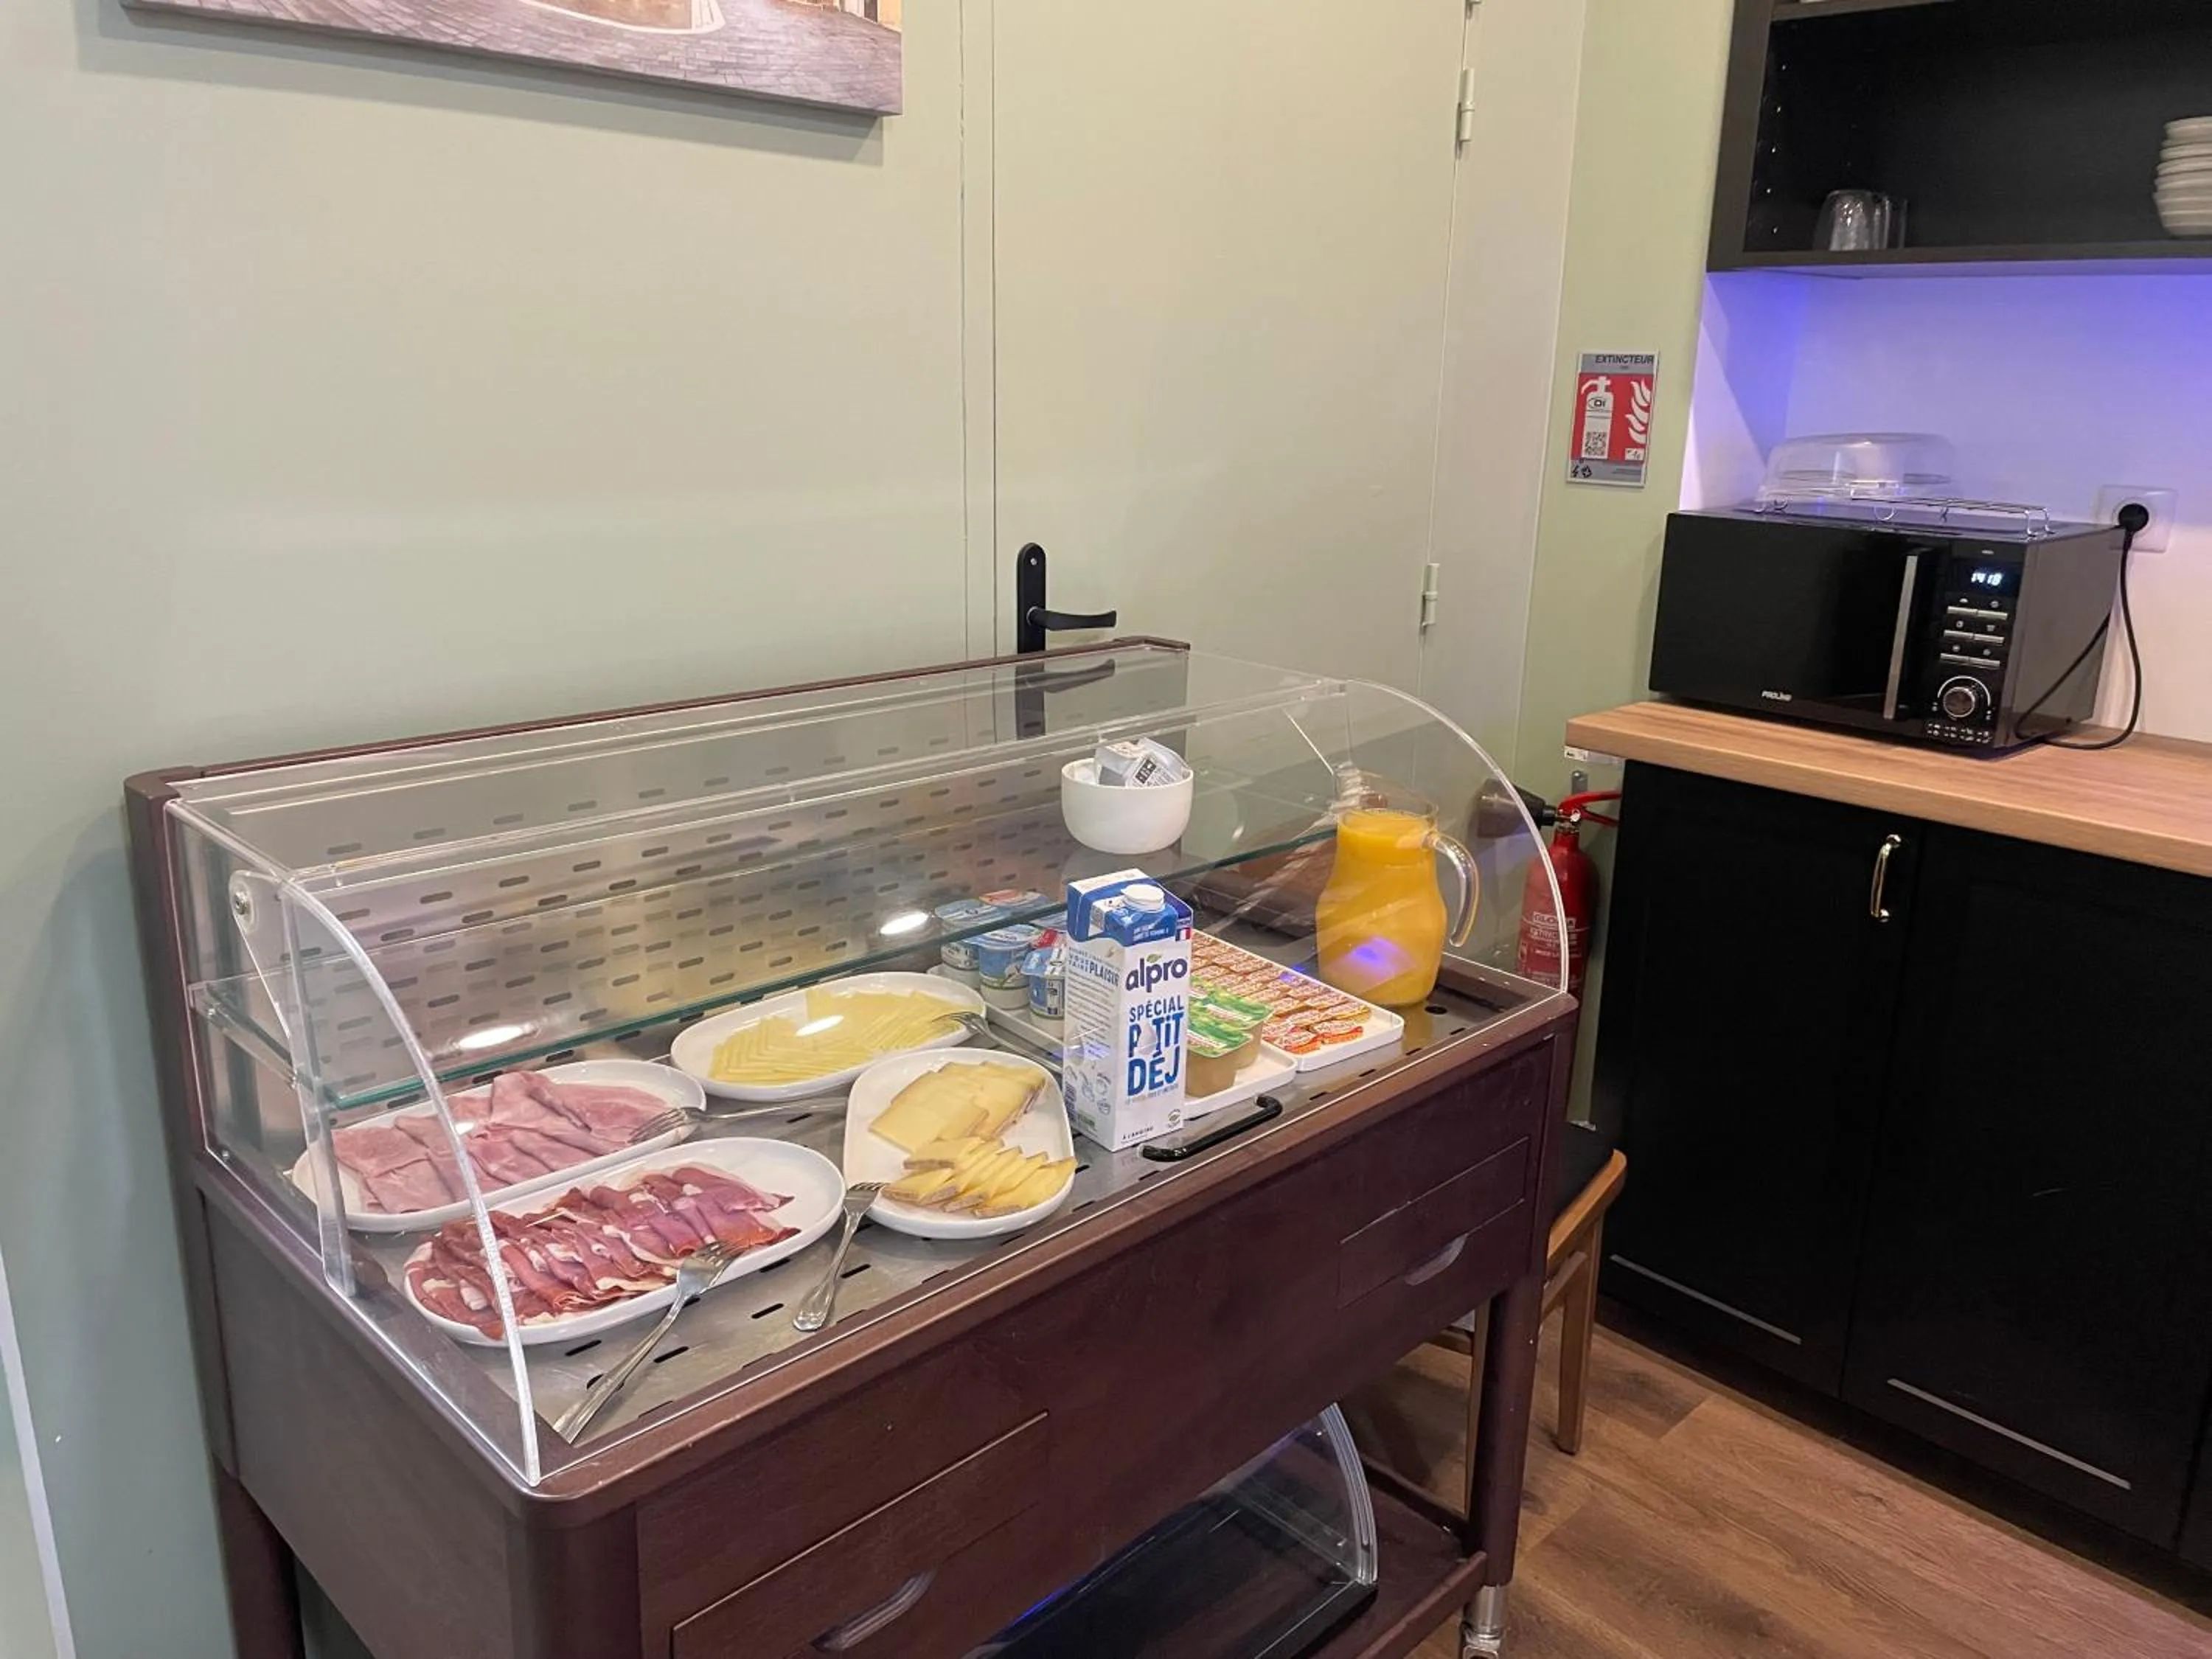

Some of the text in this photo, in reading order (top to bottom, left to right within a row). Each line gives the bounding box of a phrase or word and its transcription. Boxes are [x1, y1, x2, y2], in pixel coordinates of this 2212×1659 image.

[1595, 354, 1655, 364] EXTINCTEUR
[1125, 958, 1188, 992] alpro
[1130, 995, 1184, 1023] SPÉCIAL
[1127, 1046, 1180, 1096] DÉJ
